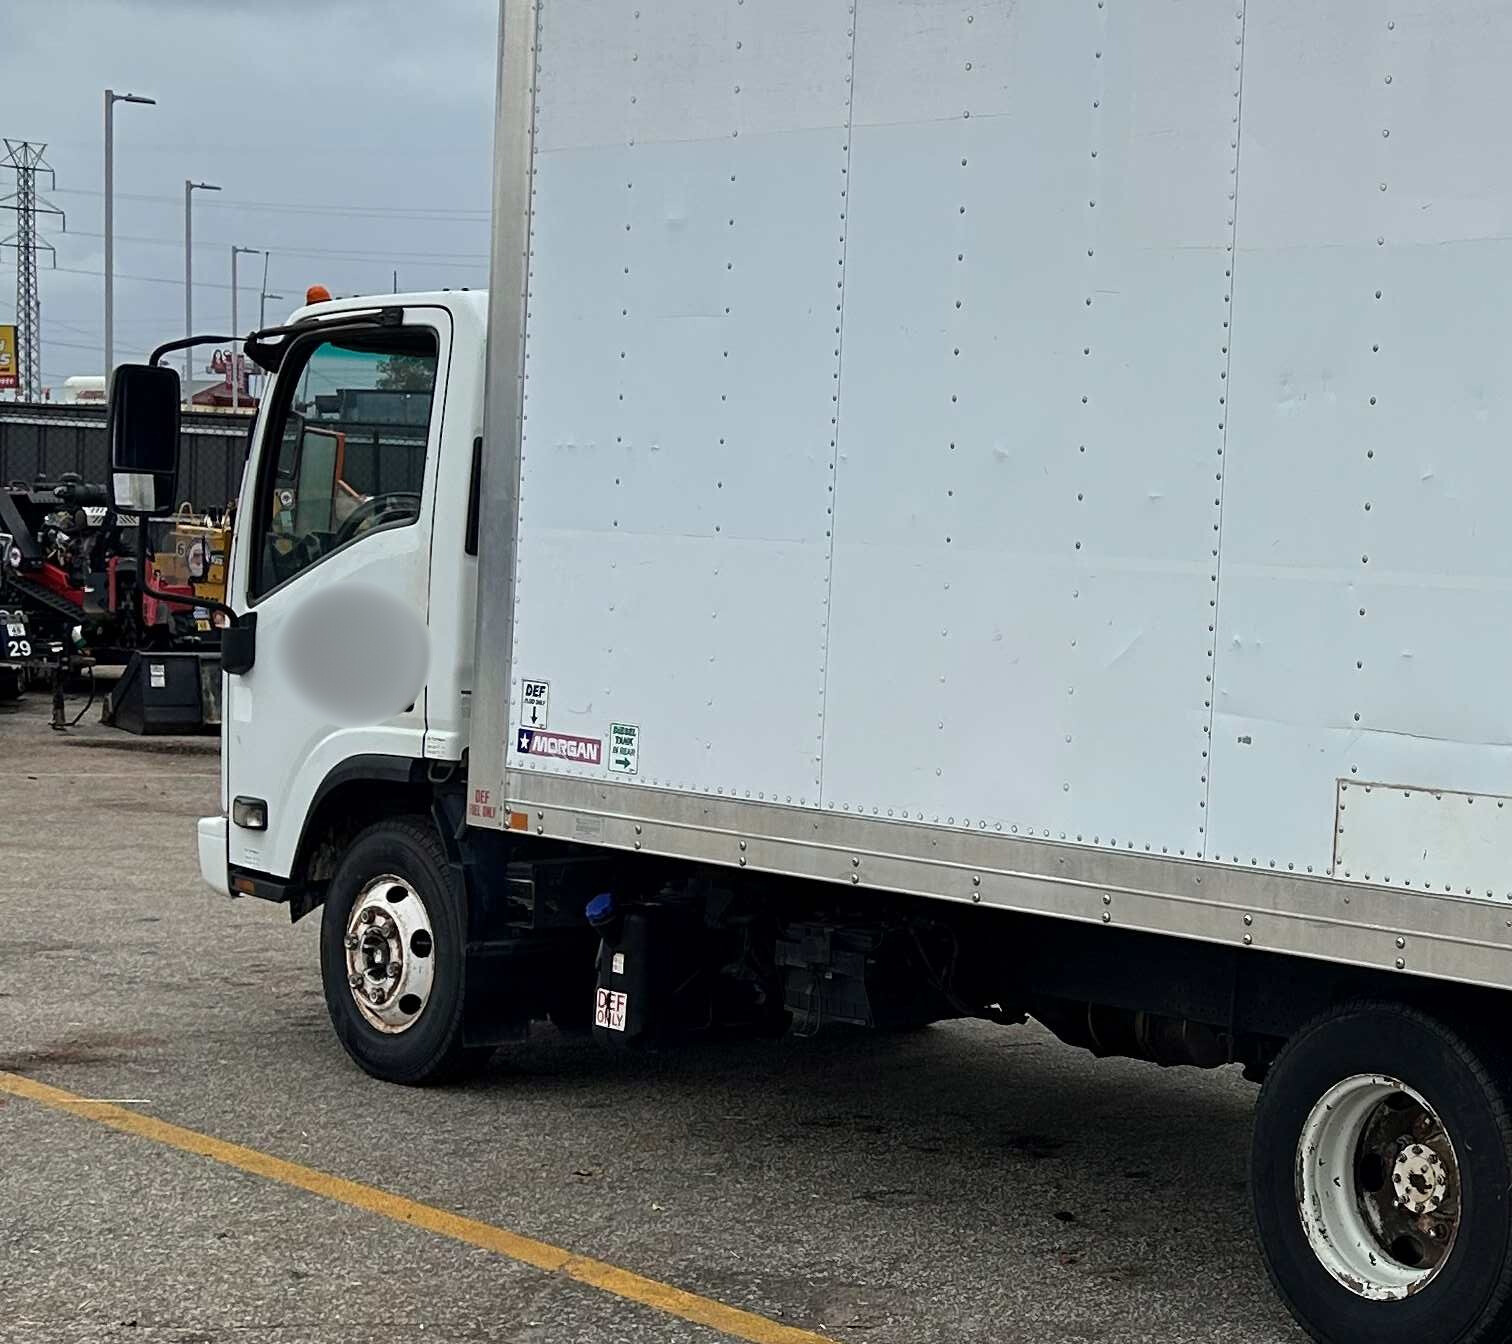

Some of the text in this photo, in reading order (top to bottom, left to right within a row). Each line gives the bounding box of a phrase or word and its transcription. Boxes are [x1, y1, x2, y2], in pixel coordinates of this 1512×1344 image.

[8, 640, 32, 657] 29
[525, 683, 546, 698] DEF
[531, 735, 598, 761] MORGAN
[475, 789, 490, 804] DEF
[598, 990, 626, 1012] DEF
[597, 1008, 624, 1028] ONLY
